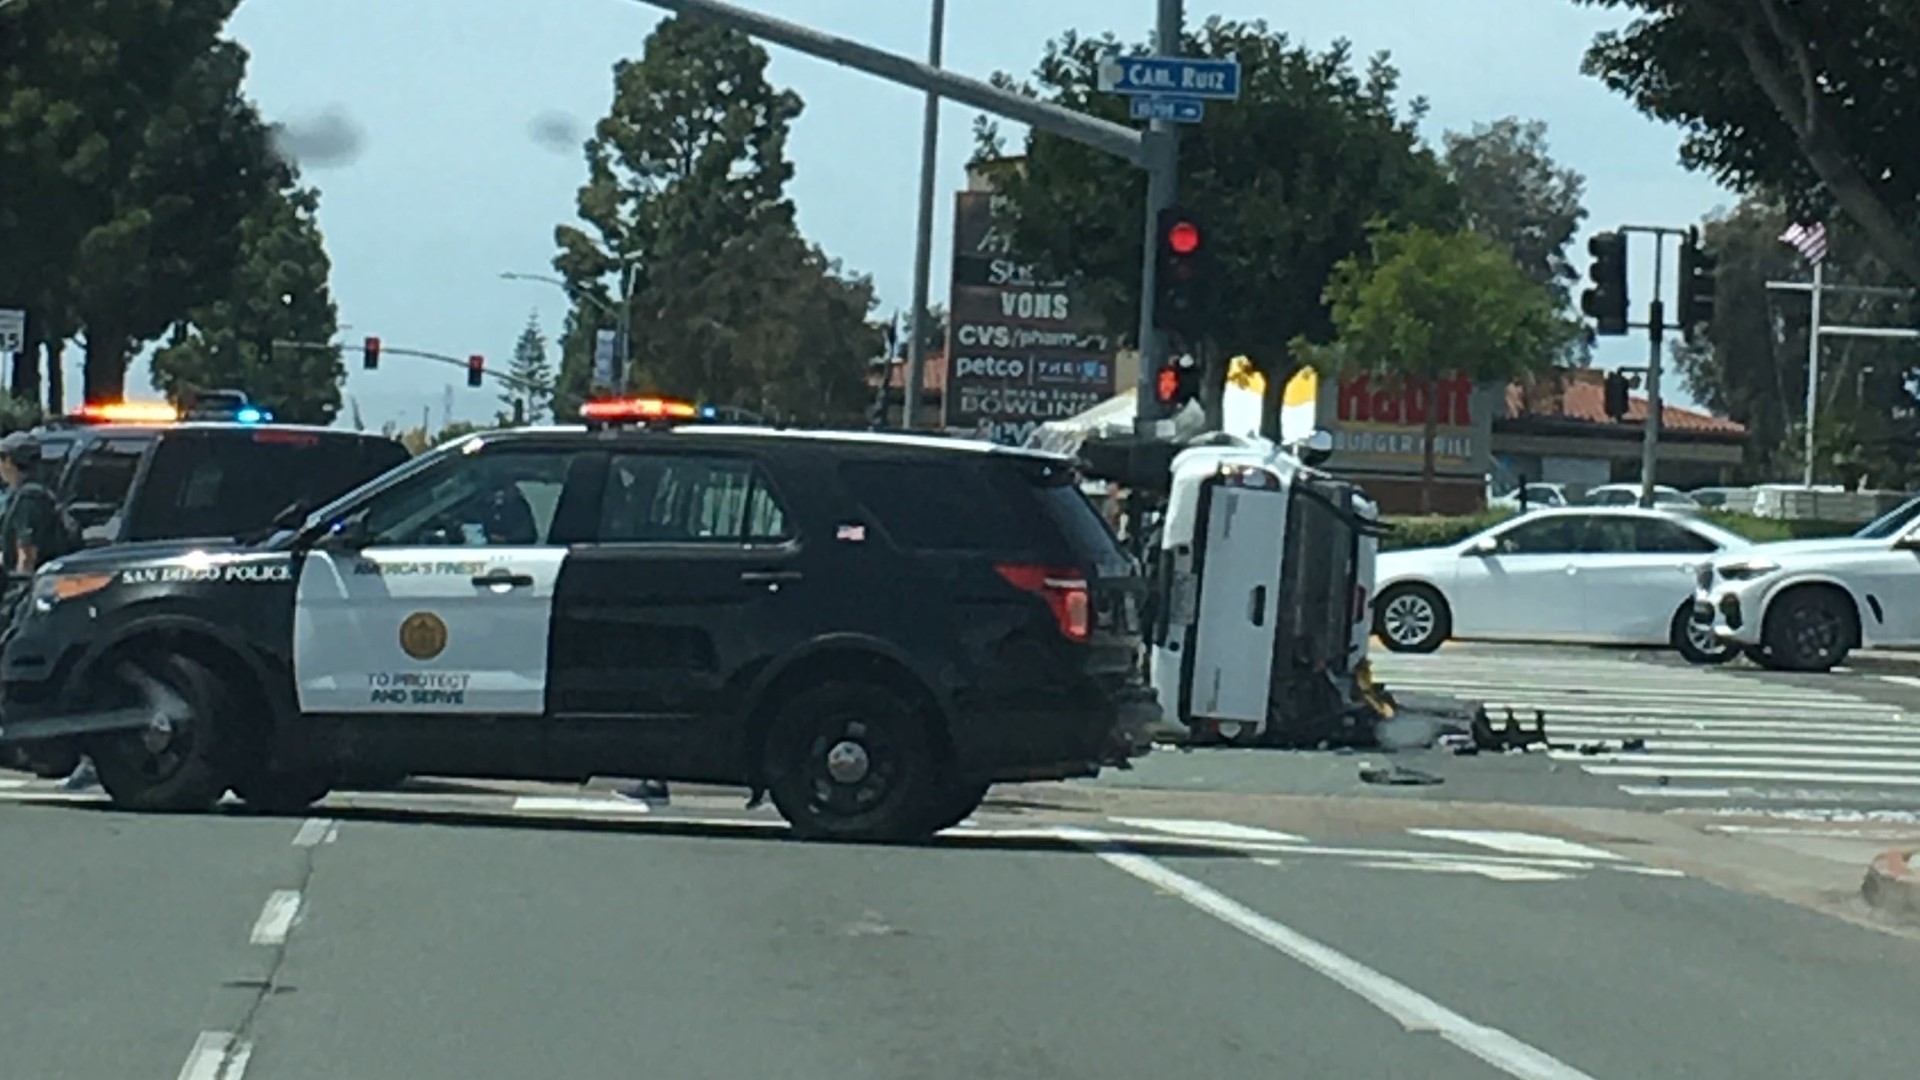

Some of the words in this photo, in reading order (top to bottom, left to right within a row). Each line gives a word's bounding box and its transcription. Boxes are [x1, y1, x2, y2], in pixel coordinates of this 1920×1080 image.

[1182, 66, 1226, 90] RUIZ
[1001, 292, 1069, 319] VONS
[956, 356, 1025, 377] petco
[1333, 431, 1412, 452] BURGER
[122, 570, 157, 584] SAN
[161, 566, 220, 582] DIEGO
[224, 565, 292, 581] POLICE
[368, 673, 389, 687] TO
[392, 673, 471, 689] PROTECT
[370, 689, 407, 704] AND
[411, 689, 465, 705] SERVE
